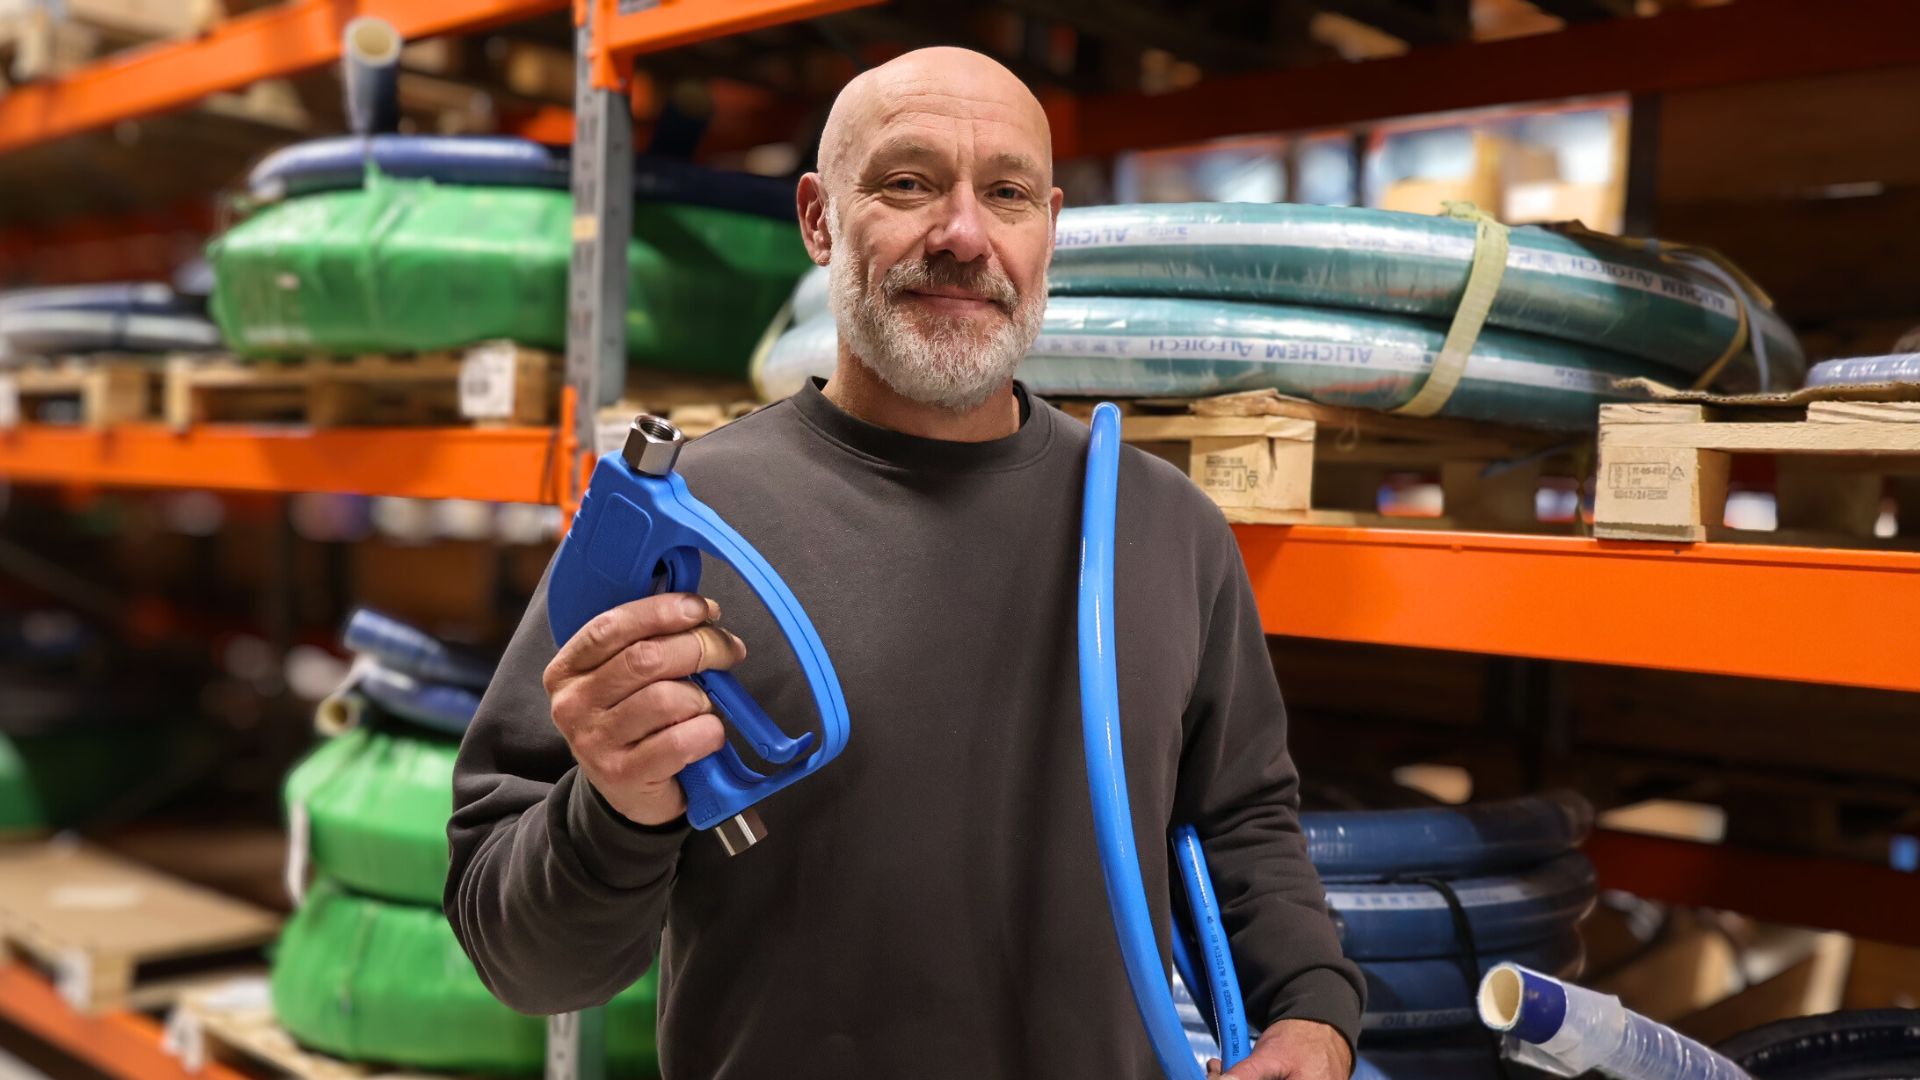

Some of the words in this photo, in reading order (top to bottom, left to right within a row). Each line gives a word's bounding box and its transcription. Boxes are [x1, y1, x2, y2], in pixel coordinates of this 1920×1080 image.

[1055, 225, 1129, 246] ALICHE
[1150, 338, 1253, 357] ALFOTECH
[1266, 343, 1374, 363] ALICHEM
